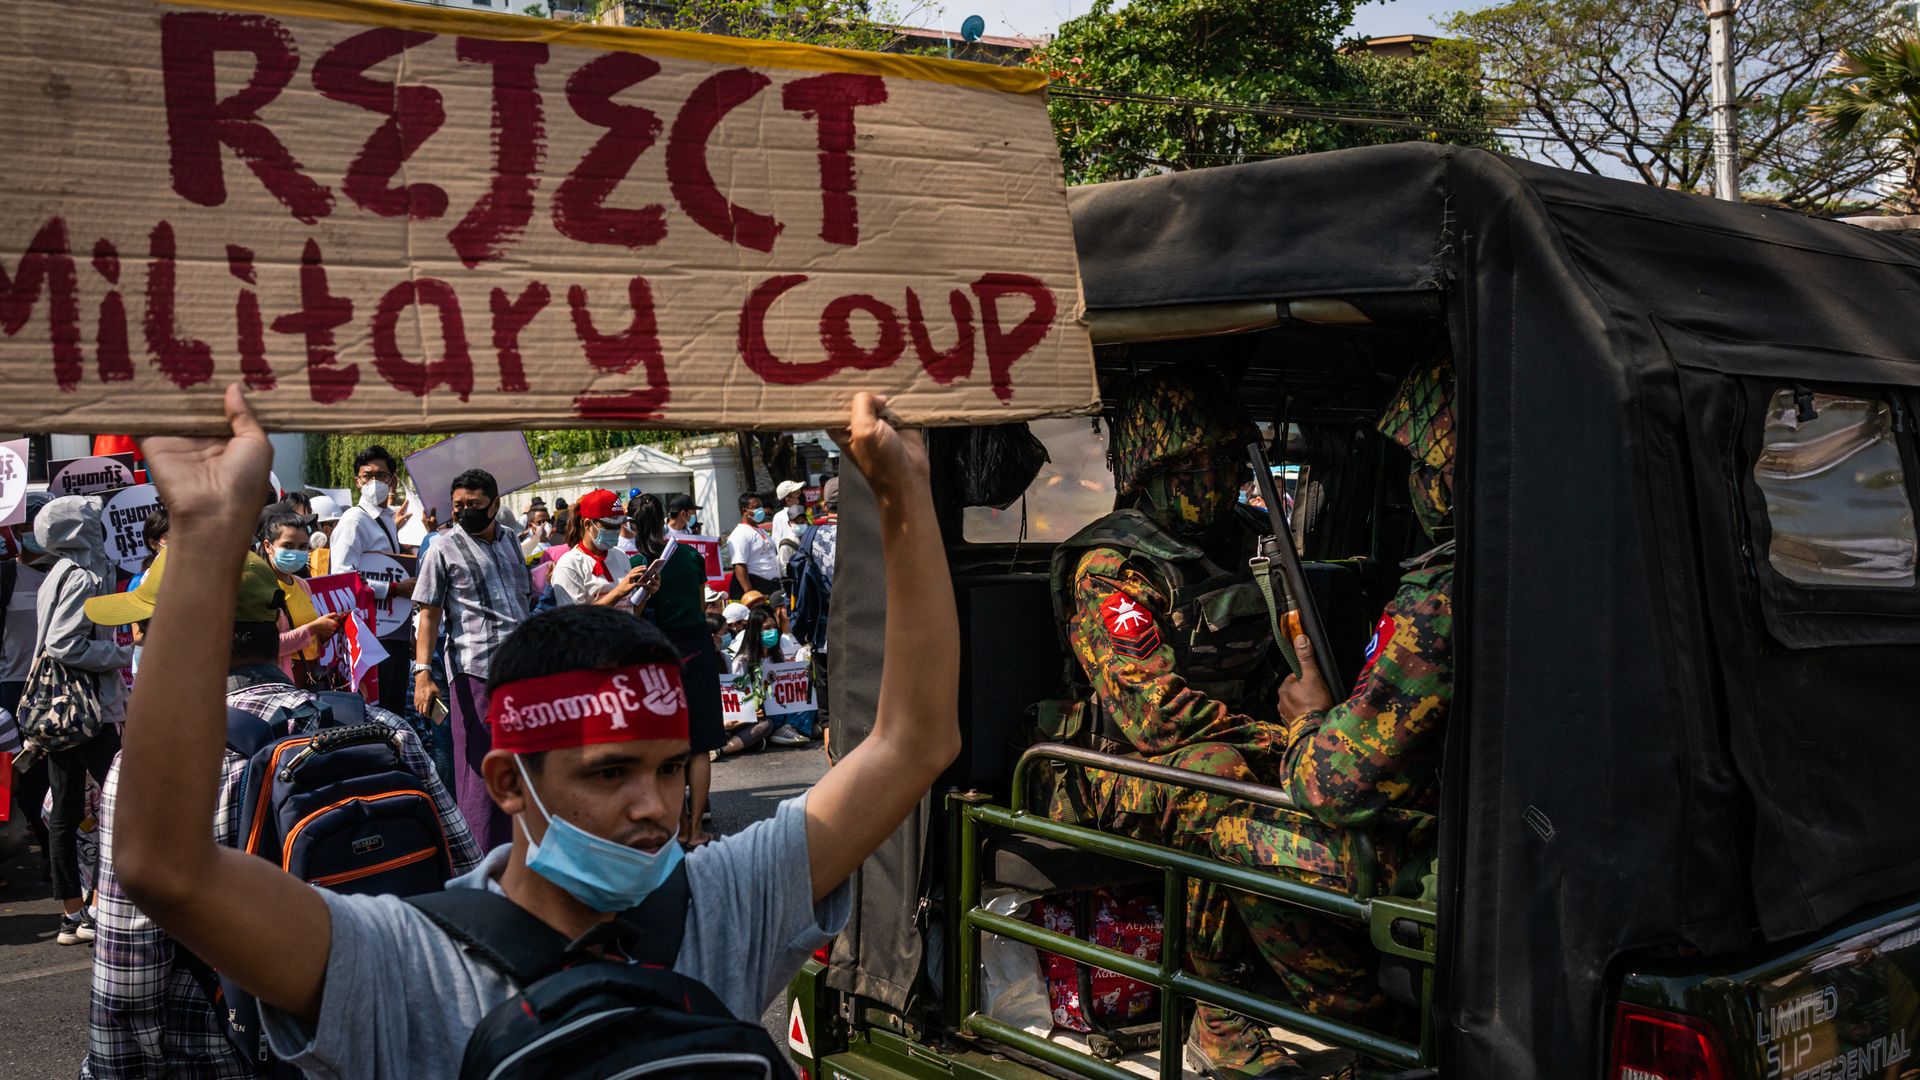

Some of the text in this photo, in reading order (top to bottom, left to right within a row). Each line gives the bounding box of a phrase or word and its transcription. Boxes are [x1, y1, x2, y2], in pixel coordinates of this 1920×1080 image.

[160, 12, 888, 268] REJECT
[774, 680, 808, 704] CDM
[1756, 985, 1839, 1047] LIMITED
[1767, 1032, 1813, 1079] SLIP
